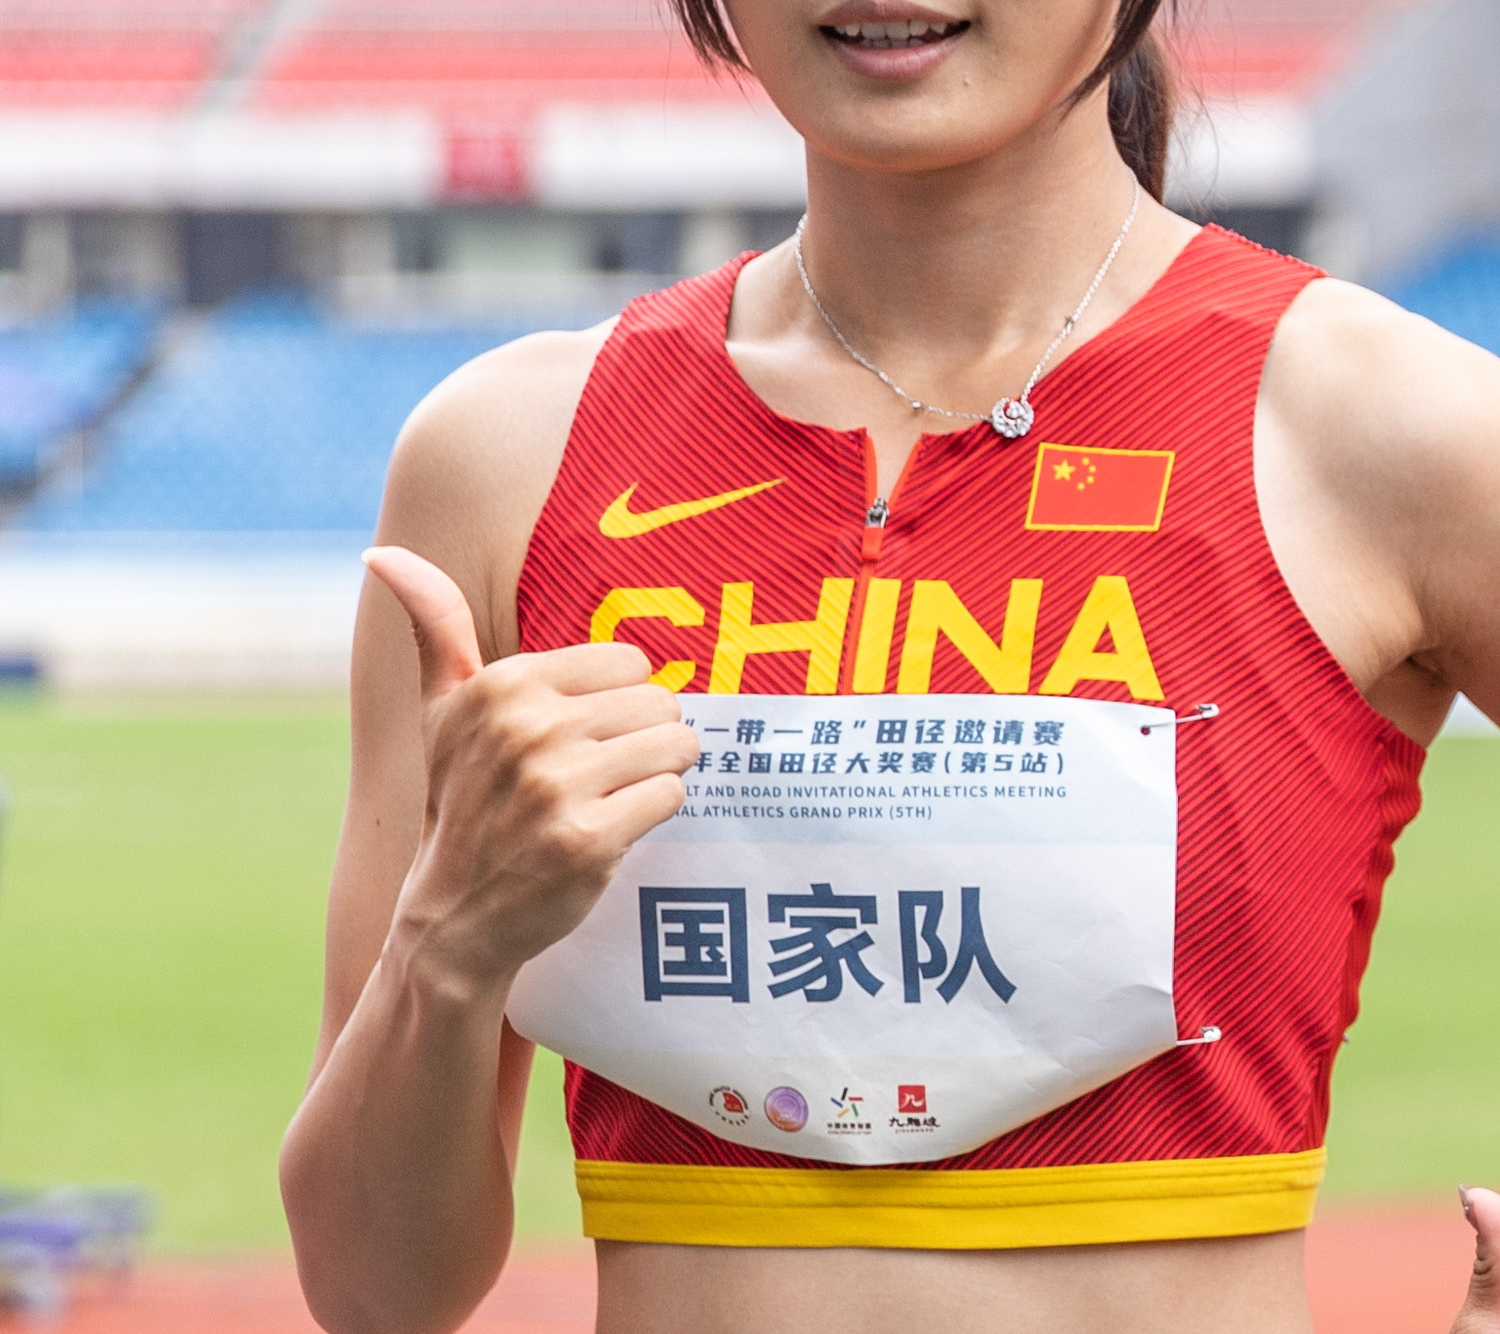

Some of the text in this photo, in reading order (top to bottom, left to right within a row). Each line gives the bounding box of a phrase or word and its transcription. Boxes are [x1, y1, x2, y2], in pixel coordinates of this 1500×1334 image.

[590, 575, 1166, 700] CHINA
[685, 718, 1066, 747] “一带一路”田径邀请赛
[694, 750, 1064, 775] 年全国田径大奖赛(第5站)
[686, 784, 1067, 799] LT AND ROAD INVITATIONAL ATHLETICS MEETING
[703, 805, 785, 819] ATHLETICS
[789, 806, 843, 819] GRAND
[847, 806, 884, 819] PRIX
[889, 806, 932, 820] (5TH)
[638, 882, 1018, 1005] 国家队
